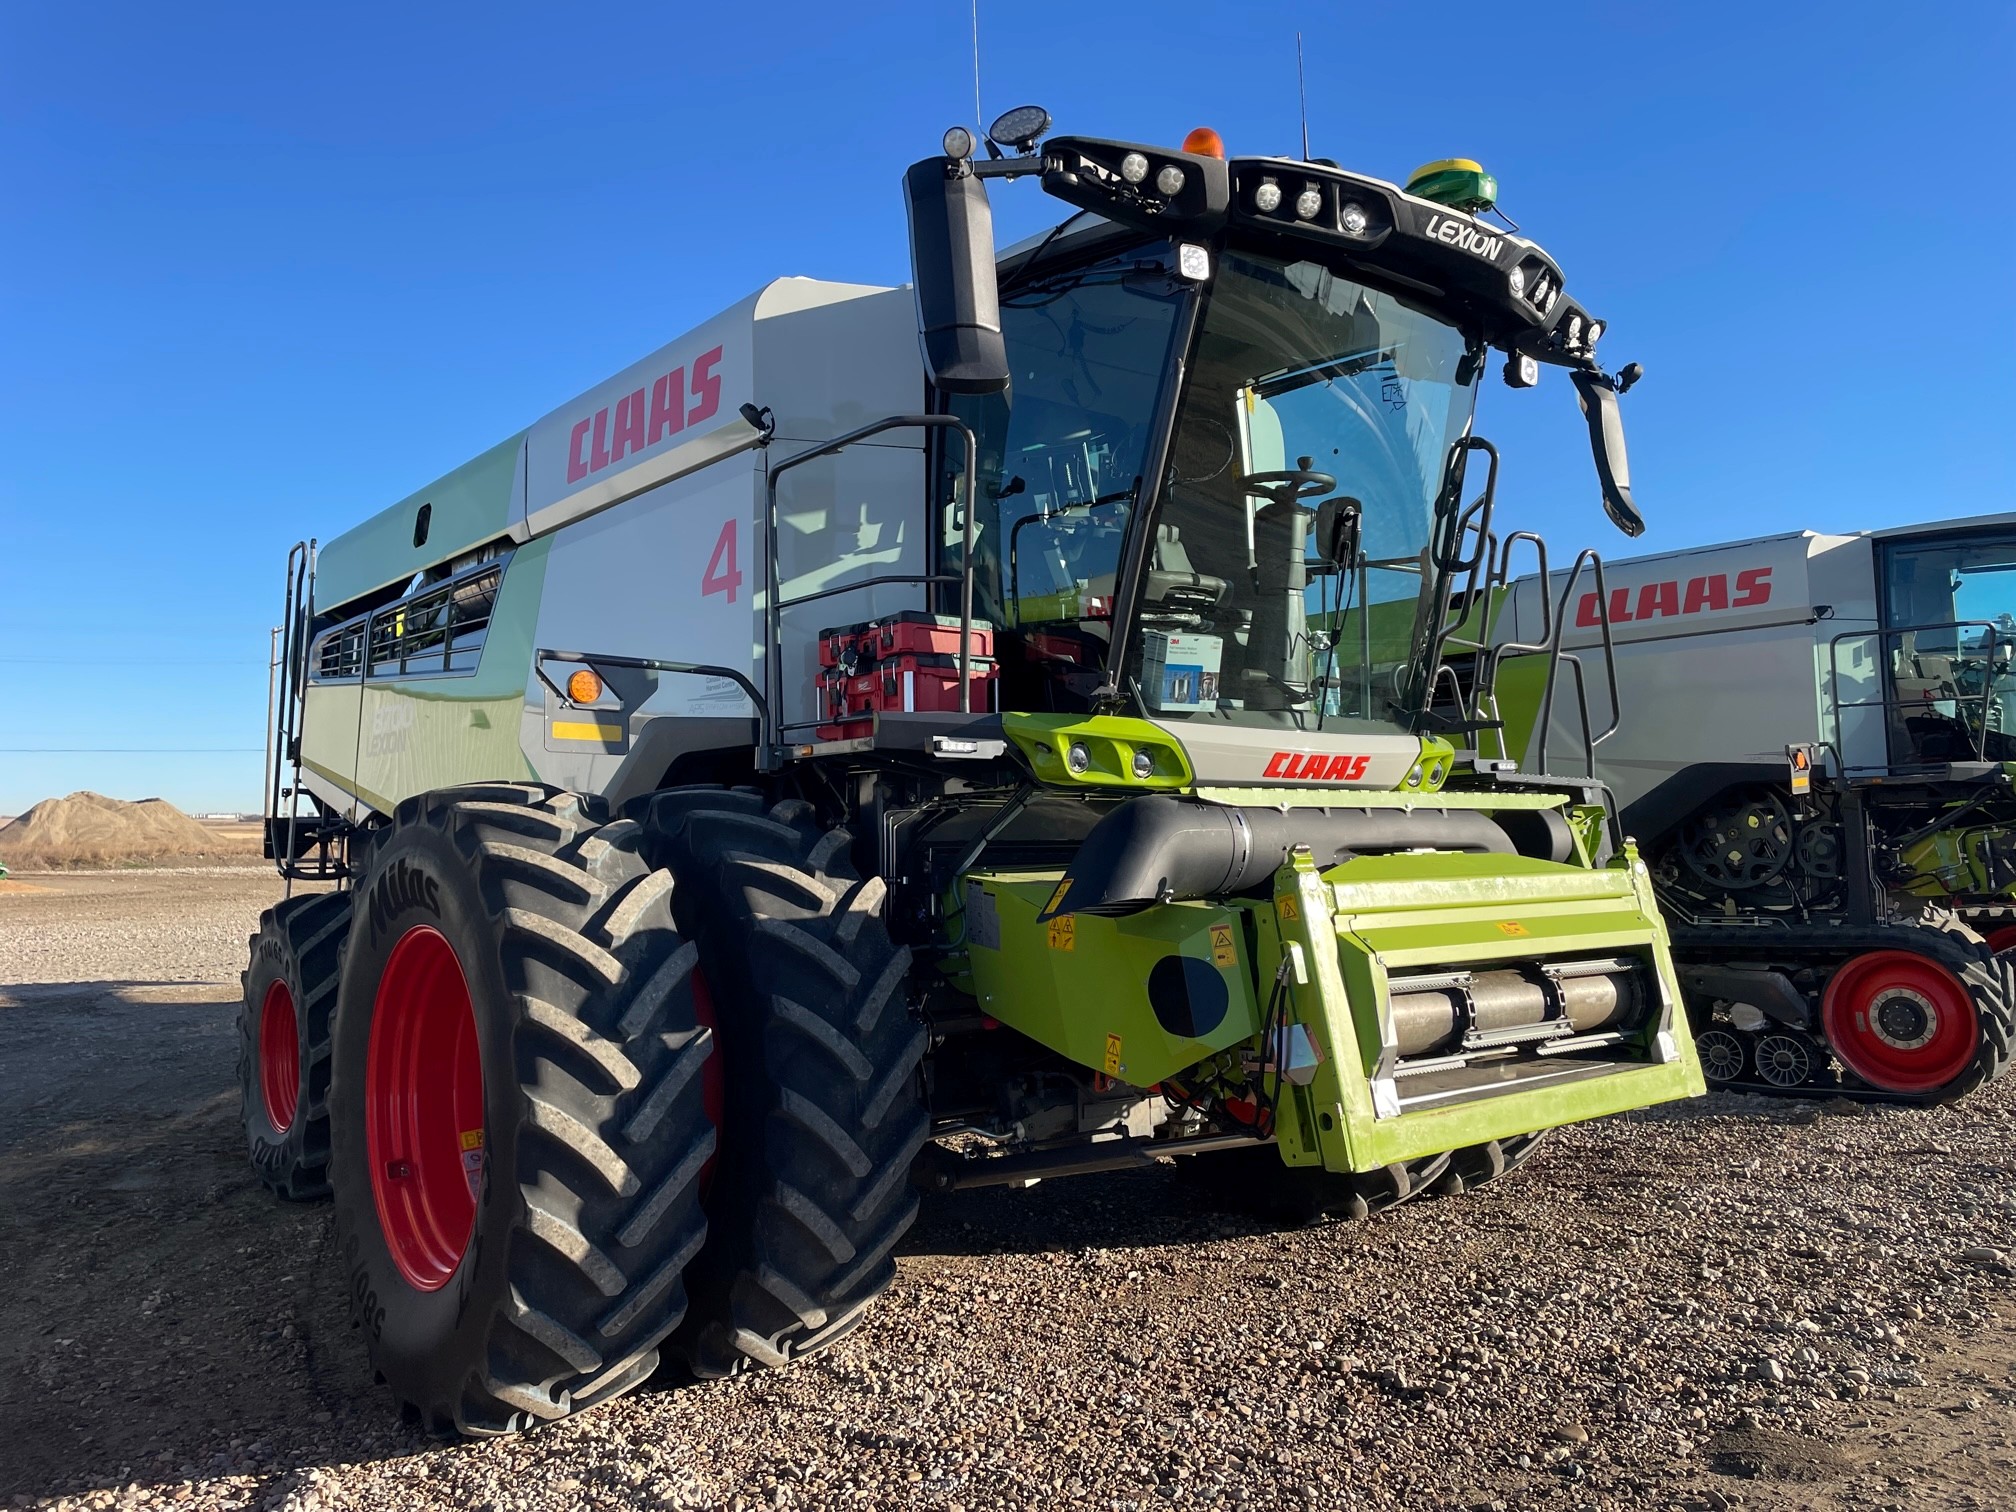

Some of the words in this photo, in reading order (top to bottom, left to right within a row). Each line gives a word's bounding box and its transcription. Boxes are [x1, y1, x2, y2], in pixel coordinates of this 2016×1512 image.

[1426, 214, 1503, 261] LEXION
[567, 344, 723, 485] CLAAS
[702, 518, 742, 604] 4
[1575, 567, 1773, 628] CLAAS
[1262, 752, 1371, 780] CLAAS
[368, 857, 441, 951] Mitas
